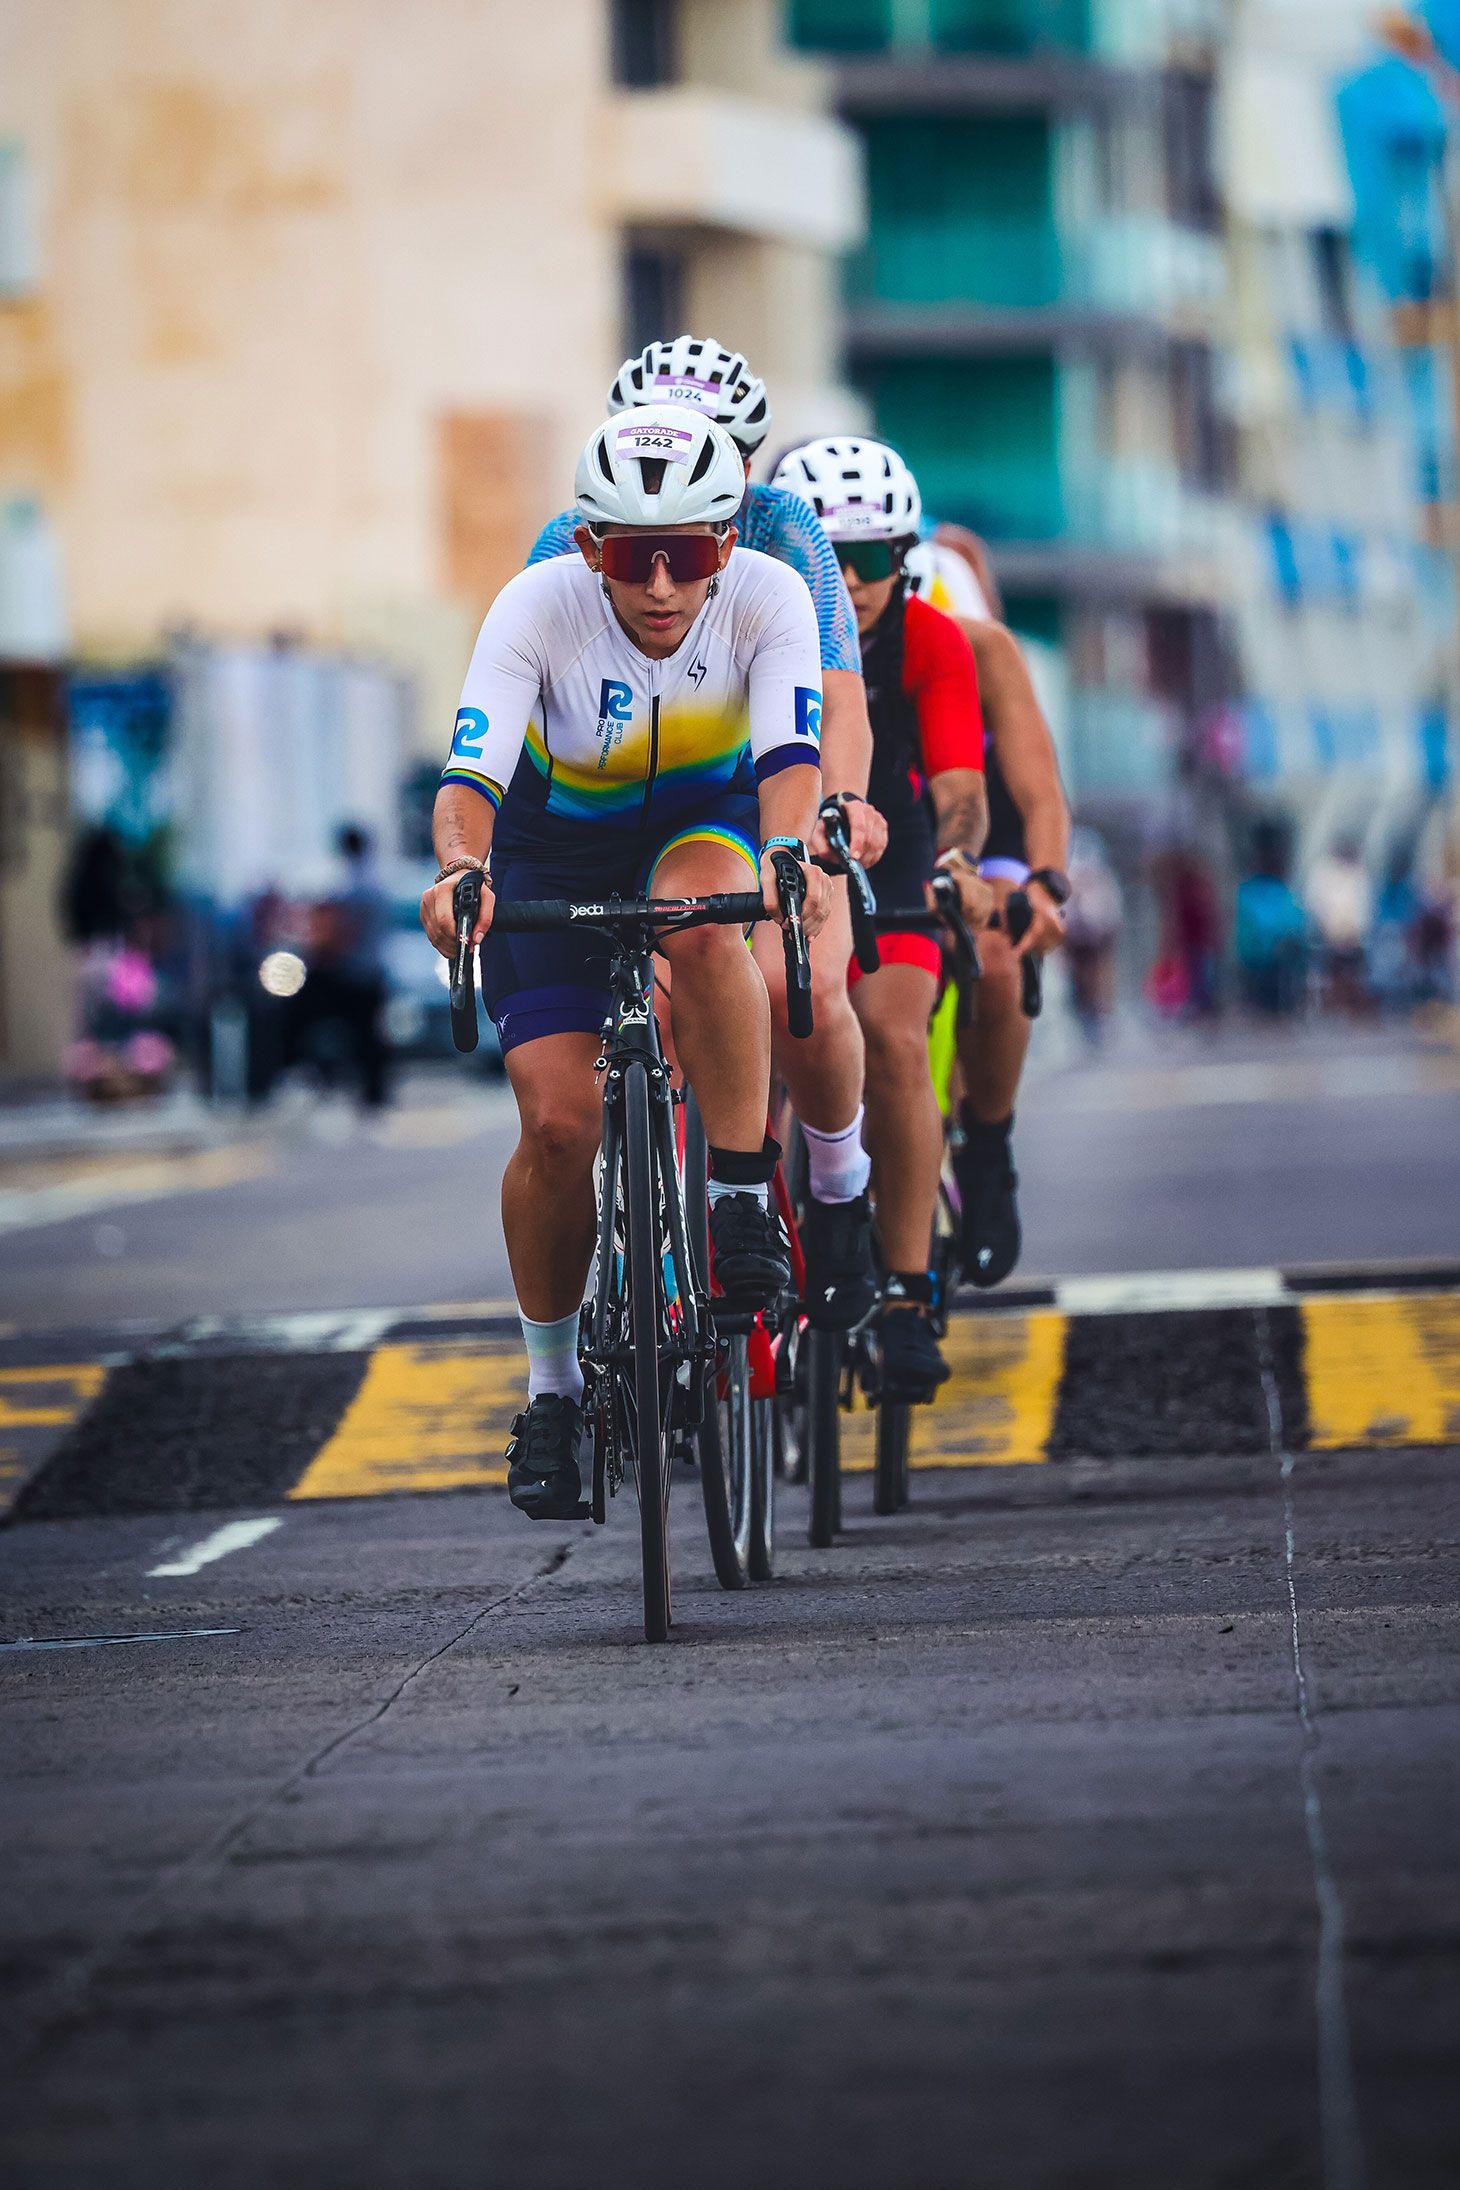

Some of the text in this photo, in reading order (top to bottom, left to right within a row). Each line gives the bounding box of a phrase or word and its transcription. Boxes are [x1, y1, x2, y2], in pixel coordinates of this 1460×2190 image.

[668, 388, 702, 402] 1024
[630, 427, 680, 437] GATORADE
[635, 437, 673, 449] 1242
[596, 720, 605, 737] PRO
[614, 722, 623, 744] CLUB
